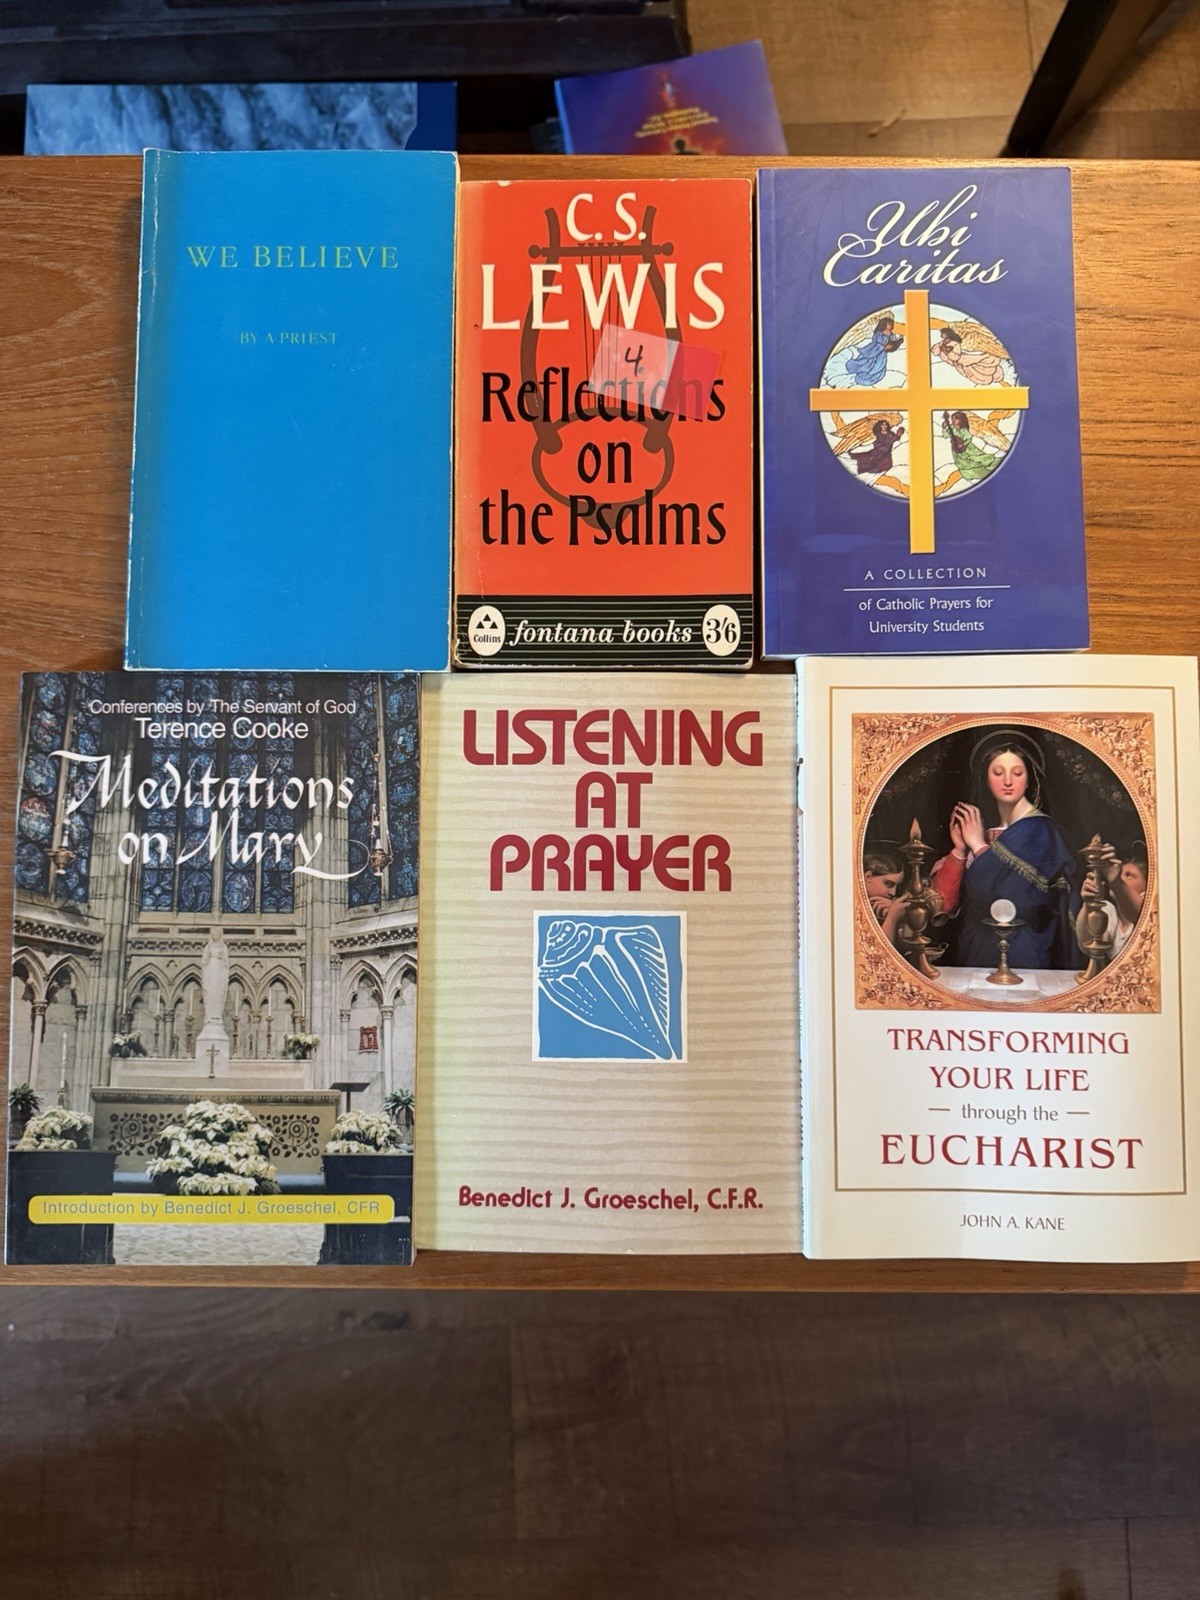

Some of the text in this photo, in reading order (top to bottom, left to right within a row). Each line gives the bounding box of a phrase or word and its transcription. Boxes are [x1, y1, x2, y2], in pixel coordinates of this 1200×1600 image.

[566, 192, 647, 241] C.S.
[866, 184, 978, 248] Ubi
[186, 245, 400, 269] WE BELIEVE
[822, 232, 1008, 287] Caritas
[481, 262, 726, 330] LEWIS
[239, 331, 339, 346] BY A PRIEST
[624, 345, 644, 376] 4
[481, 366, 726, 422] Reflections
[577, 442, 632, 484] on
[479, 489, 726, 545] the Psalms
[864, 567, 987, 581] A COLLECTION
[858, 596, 994, 612] of Catholic Prayers for
[473, 633, 501, 644] Collins
[509, 620, 692, 646] fontana books
[869, 620, 985, 634] University Students
[90, 699, 356, 716] Conferences by The Servant of God
[135, 717, 309, 739] Terence Cooke
[463, 708, 763, 767] LISTENING
[48, 749, 355, 815] Meditations
[575, 771, 653, 828] AT
[117, 810, 370, 880] on Mary
[489, 834, 732, 892] PRAYER
[887, 1028, 1130, 1054] TRANSFORMING
[929, 1066, 1091, 1092] YOUR LIFE
[961, 1104, 1059, 1125] through the
[880, 1134, 1144, 1170] EUCHARIST
[42, 1200, 380, 1218] Introduction by Benedict J. Groeschel, CFR
[458, 1185, 764, 1213] Benedict J. Groeschel, C.F.R.
[960, 1214, 1066, 1231] JOHN A. KANE
